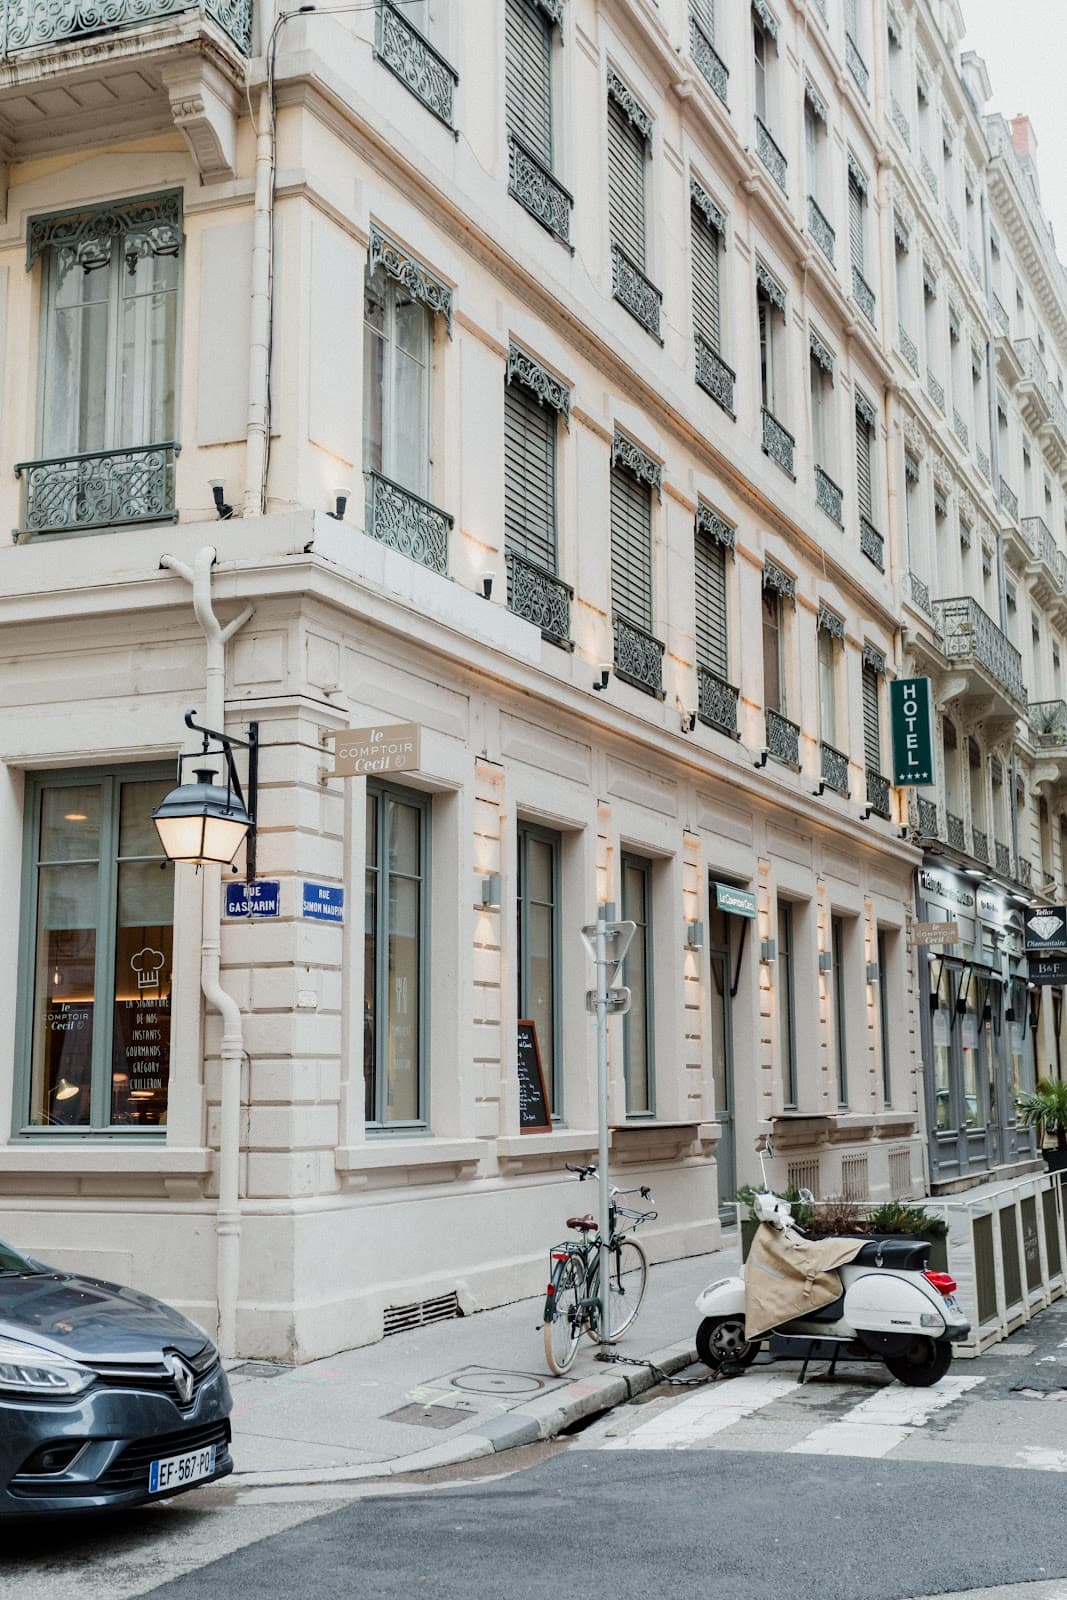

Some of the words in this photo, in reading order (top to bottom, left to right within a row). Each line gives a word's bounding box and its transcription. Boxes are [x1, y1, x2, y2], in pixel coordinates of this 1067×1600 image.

[903, 684, 919, 766] HOTEL
[370, 729, 383, 743] le
[339, 743, 413, 759] COMPTOIR
[354, 756, 390, 772] Cecil
[243, 886, 261, 897] RUE
[318, 889, 331, 900] RUE
[229, 900, 275, 913] GASPARIN
[303, 900, 322, 914] SIMON
[1026, 939, 1066, 948] Diamantaire
[61, 1003, 71, 1012] le
[136, 1013, 143, 1025] DE
[146, 1013, 158, 1024] NOS
[51, 1021, 74, 1031] Cecil
[132, 1029, 161, 1041] INSTANTS
[125, 1045, 161, 1057] GOURMANDS
